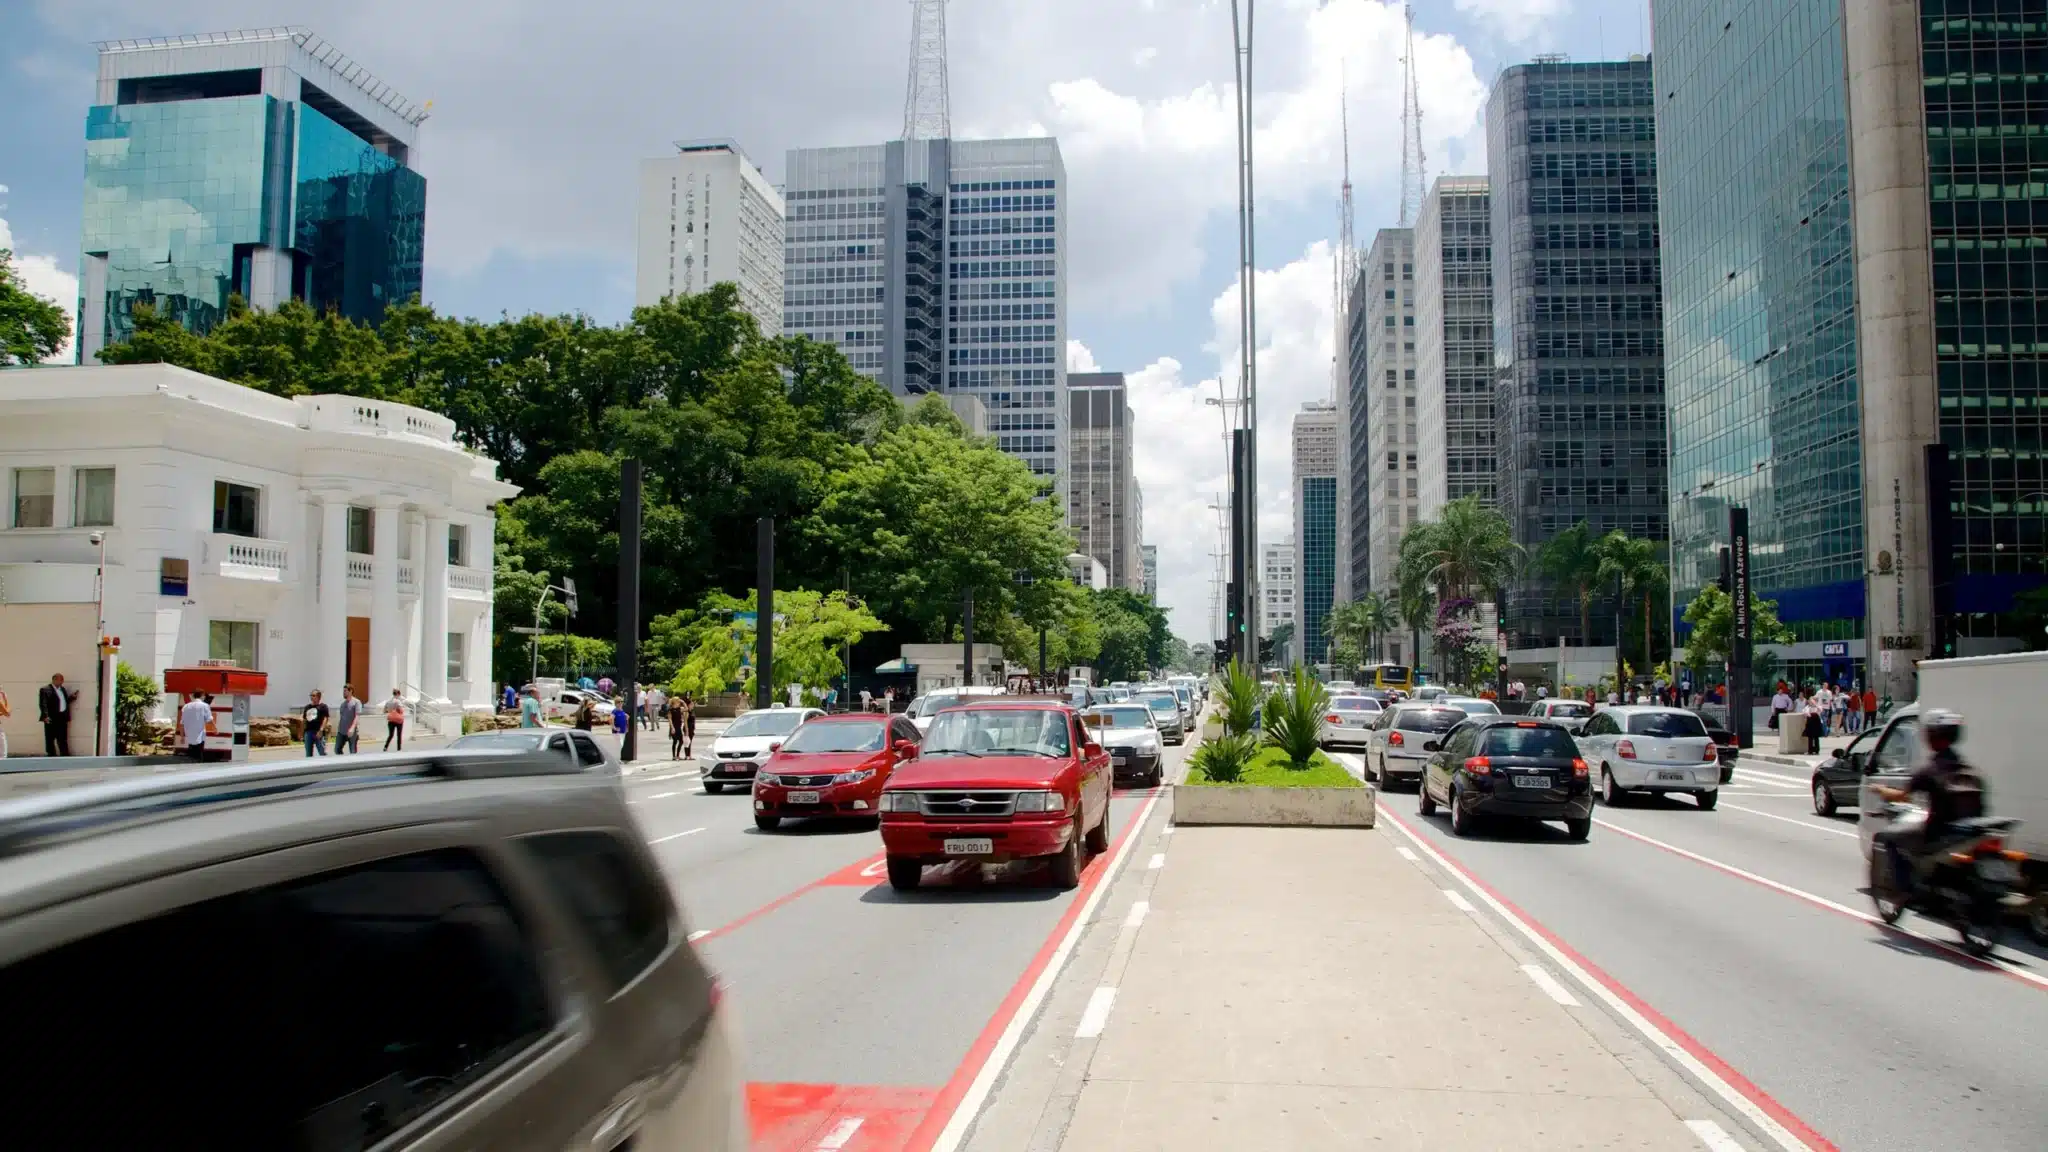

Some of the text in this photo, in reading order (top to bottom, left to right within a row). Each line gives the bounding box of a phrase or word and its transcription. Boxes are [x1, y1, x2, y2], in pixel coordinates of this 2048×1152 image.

[1893, 478, 1902, 530] TRIBUNAL
[1735, 535, 1745, 575] Azevedo
[1895, 532, 1904, 585] REGIONAL
[1882, 635, 1913, 649] 1842
